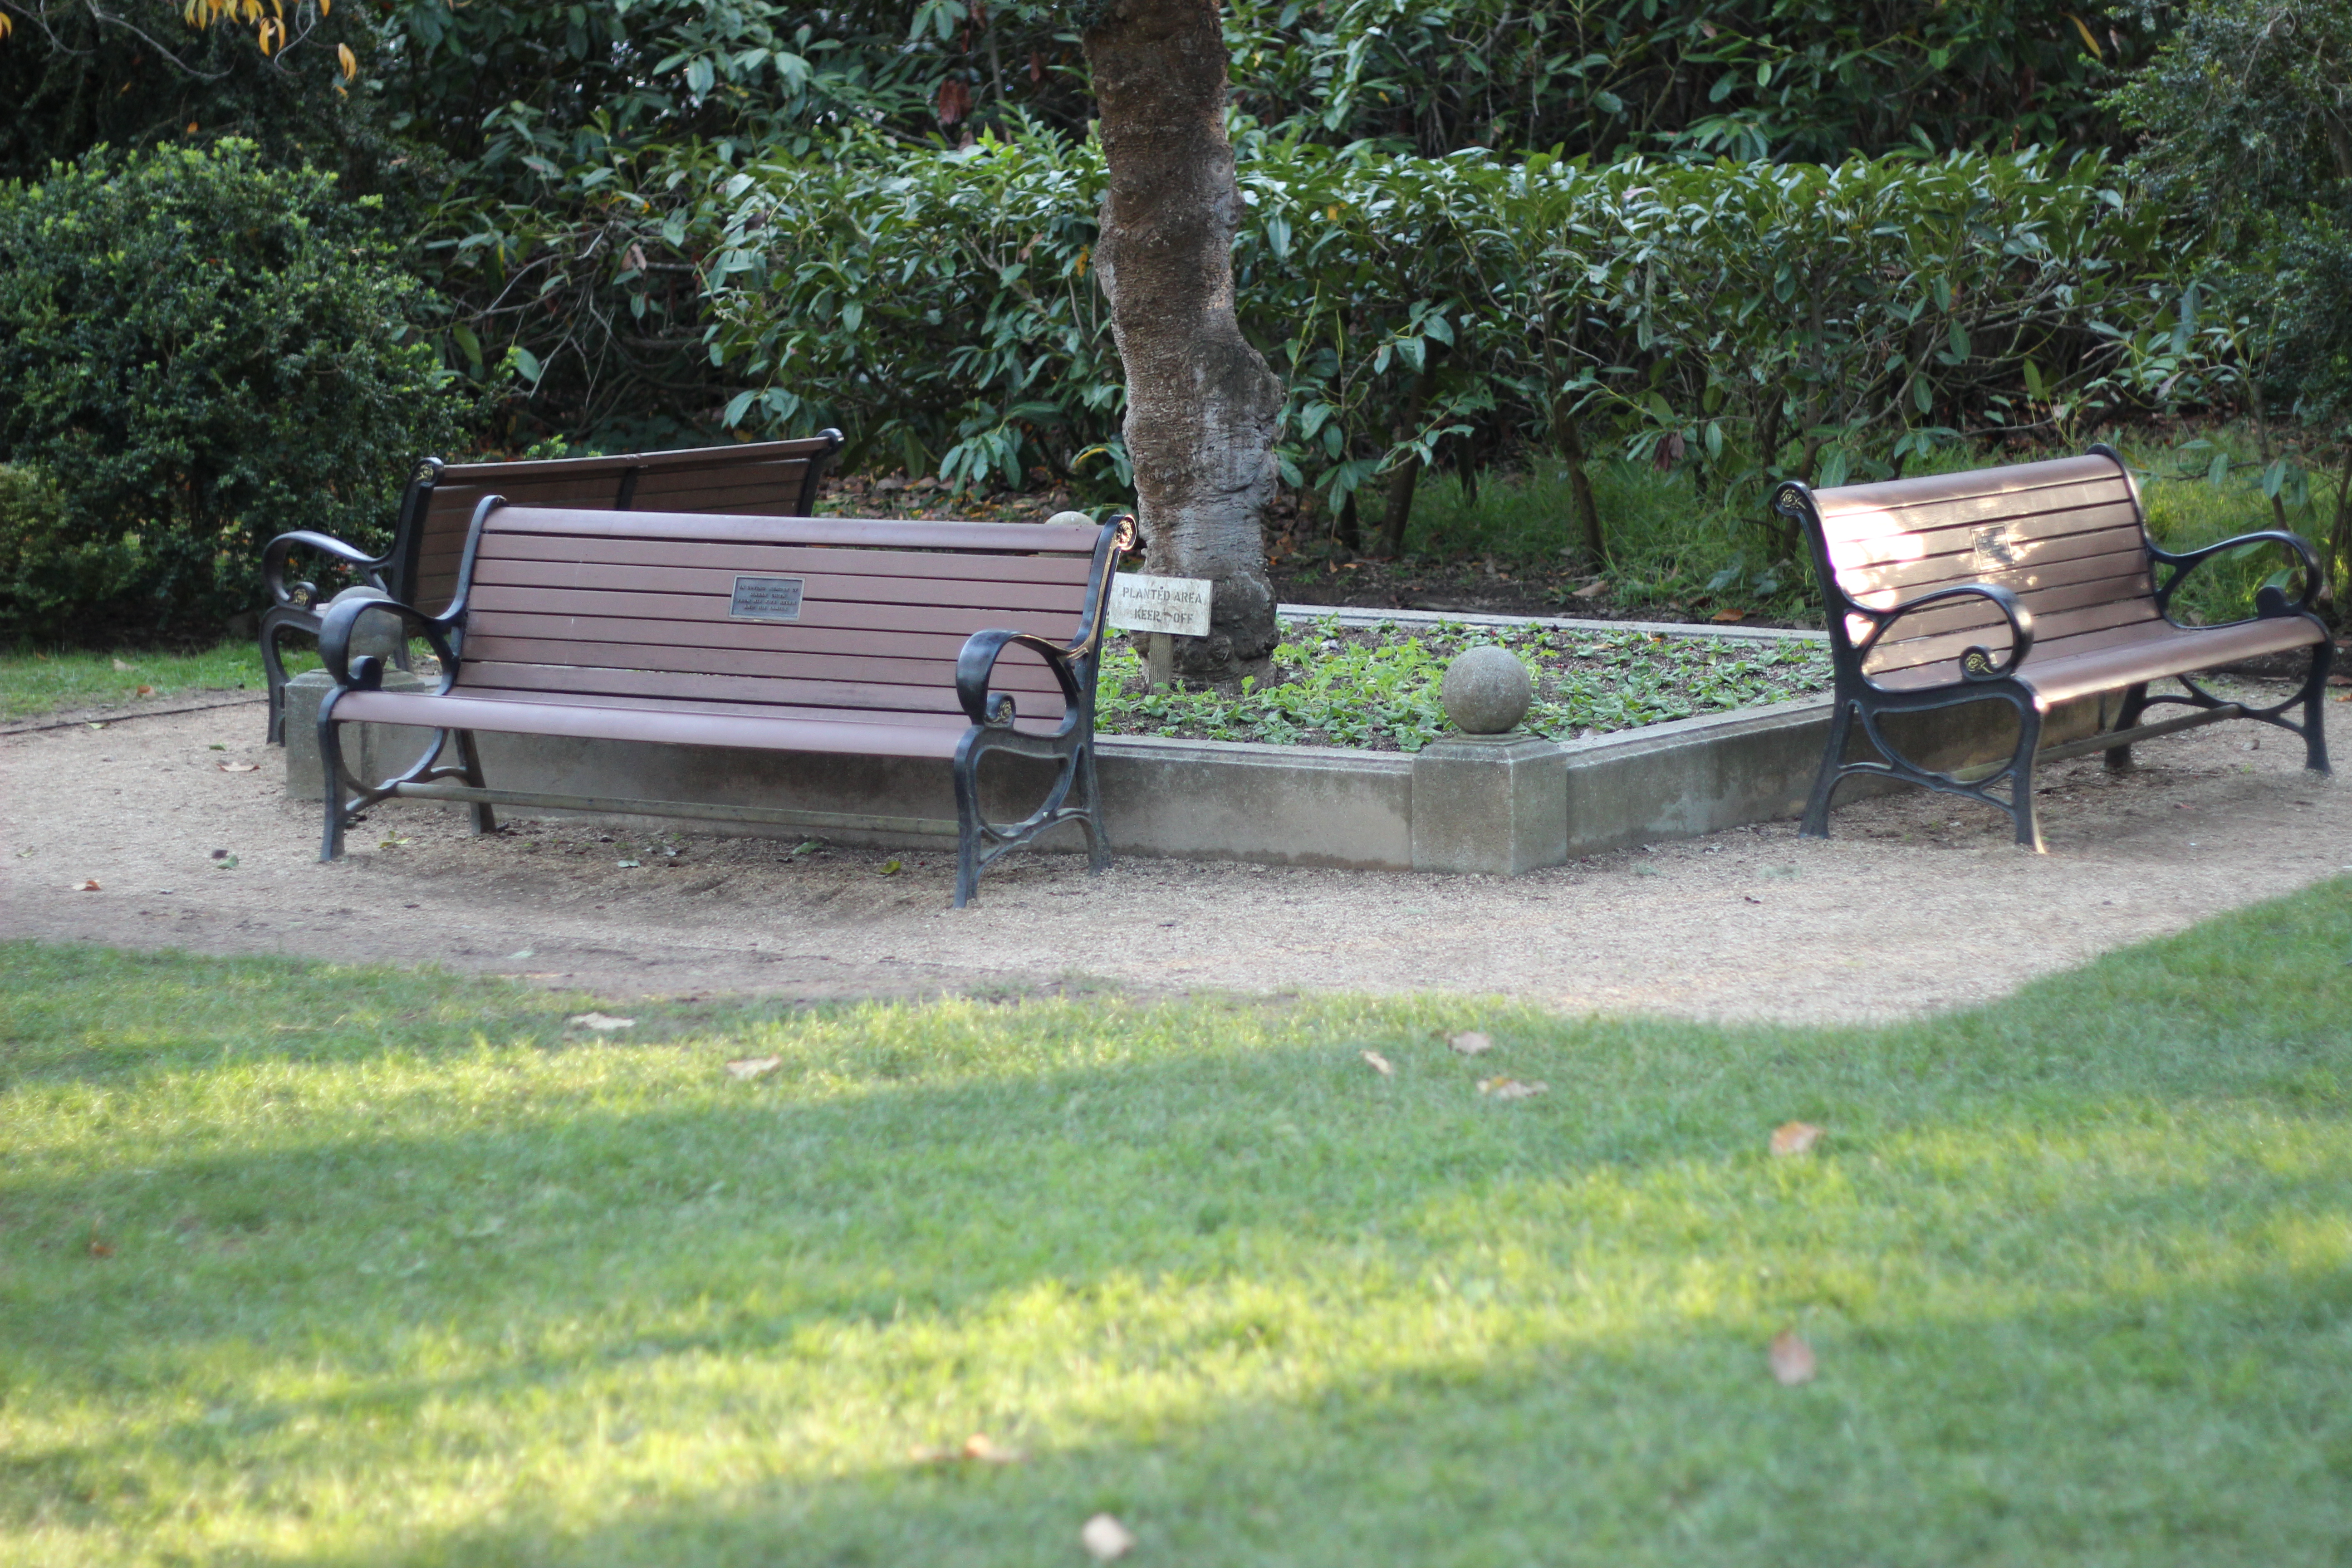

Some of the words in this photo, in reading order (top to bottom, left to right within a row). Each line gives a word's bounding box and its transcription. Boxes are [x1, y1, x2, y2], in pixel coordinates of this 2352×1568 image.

[1123, 587, 1171, 600] PLANTED
[1174, 592, 1202, 604] AREA
[1134, 608, 1161, 622] KEEP
[1173, 612, 1194, 624] OFF
